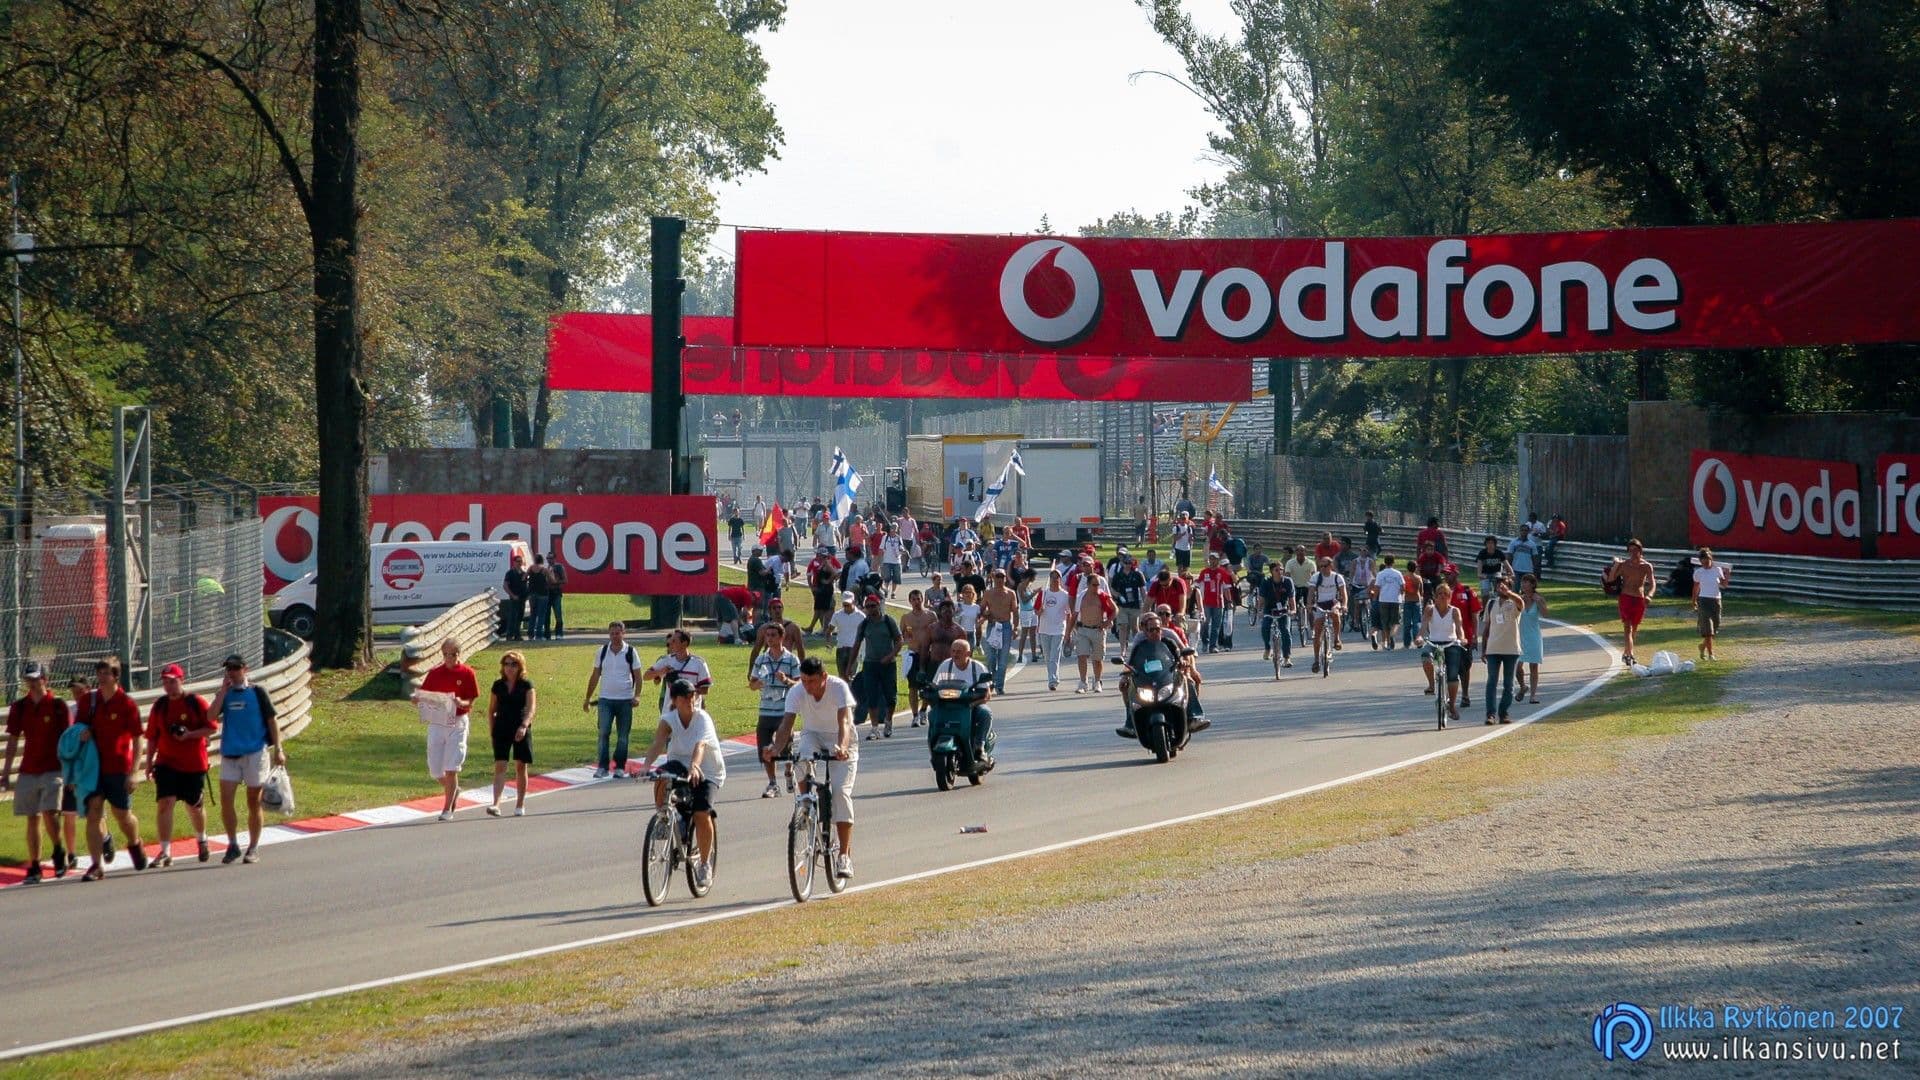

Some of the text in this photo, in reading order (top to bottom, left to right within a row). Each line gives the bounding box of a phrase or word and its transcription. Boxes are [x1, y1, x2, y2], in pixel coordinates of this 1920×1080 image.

[1131, 239, 1679, 339] vodafone
[1743, 469, 1861, 538] voda
[423, 550, 504, 559] www.buchbinder.de
